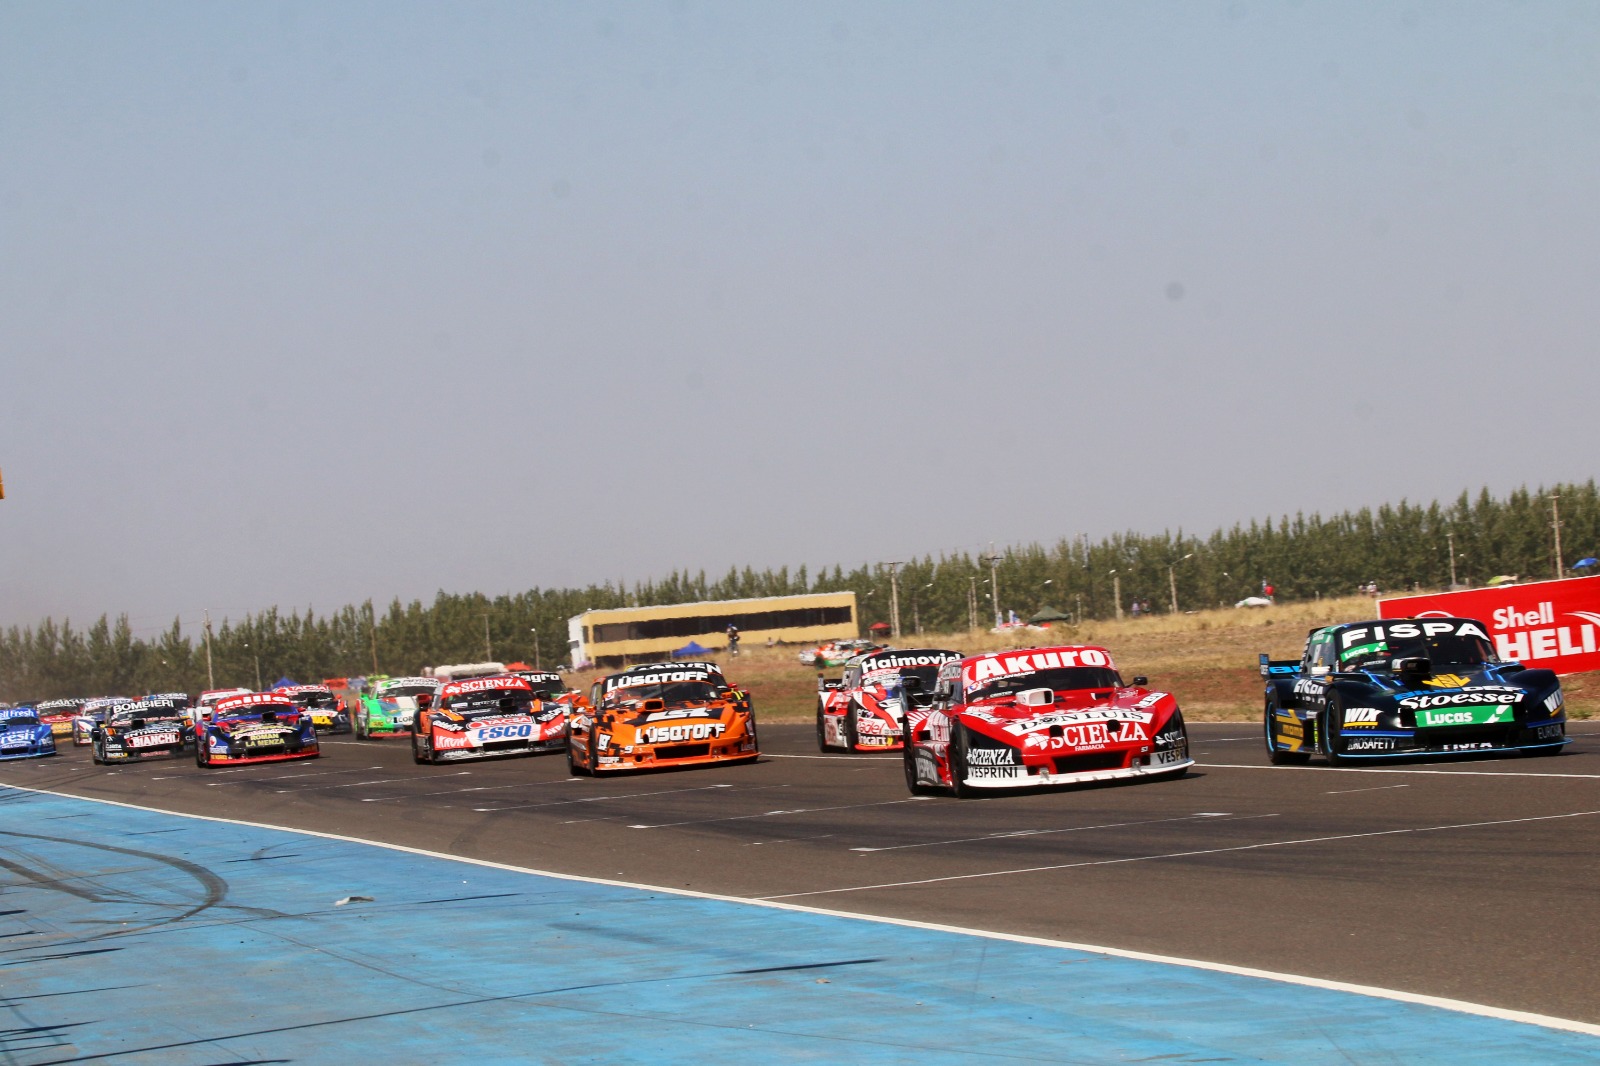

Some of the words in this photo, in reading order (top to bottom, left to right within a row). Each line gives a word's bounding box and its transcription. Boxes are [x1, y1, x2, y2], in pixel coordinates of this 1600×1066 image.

[1492, 601, 1555, 630] Shell
[1341, 622, 1491, 649] FISPA
[1493, 624, 1600, 662] HELI
[975, 650, 1107, 681] Akuro
[461, 679, 527, 692] SCIENZA
[113, 699, 174, 714] BOMBIERI
[1399, 692, 1524, 709] Stoessel
[1083, 710, 1145, 724] LUIS
[1344, 707, 1384, 723] WIX
[1425, 711, 1473, 725] Lucas
[132, 732, 178, 748] BIANCHI
[478, 724, 532, 742] ESCO
[635, 723, 727, 744] LÜSQTOFF
[1051, 722, 1149, 749] SCIENZA
[1075, 743, 1106, 752] FARMACIA
[969, 748, 1015, 765] SCIENZA
[969, 766, 1018, 779] VESPRINI
